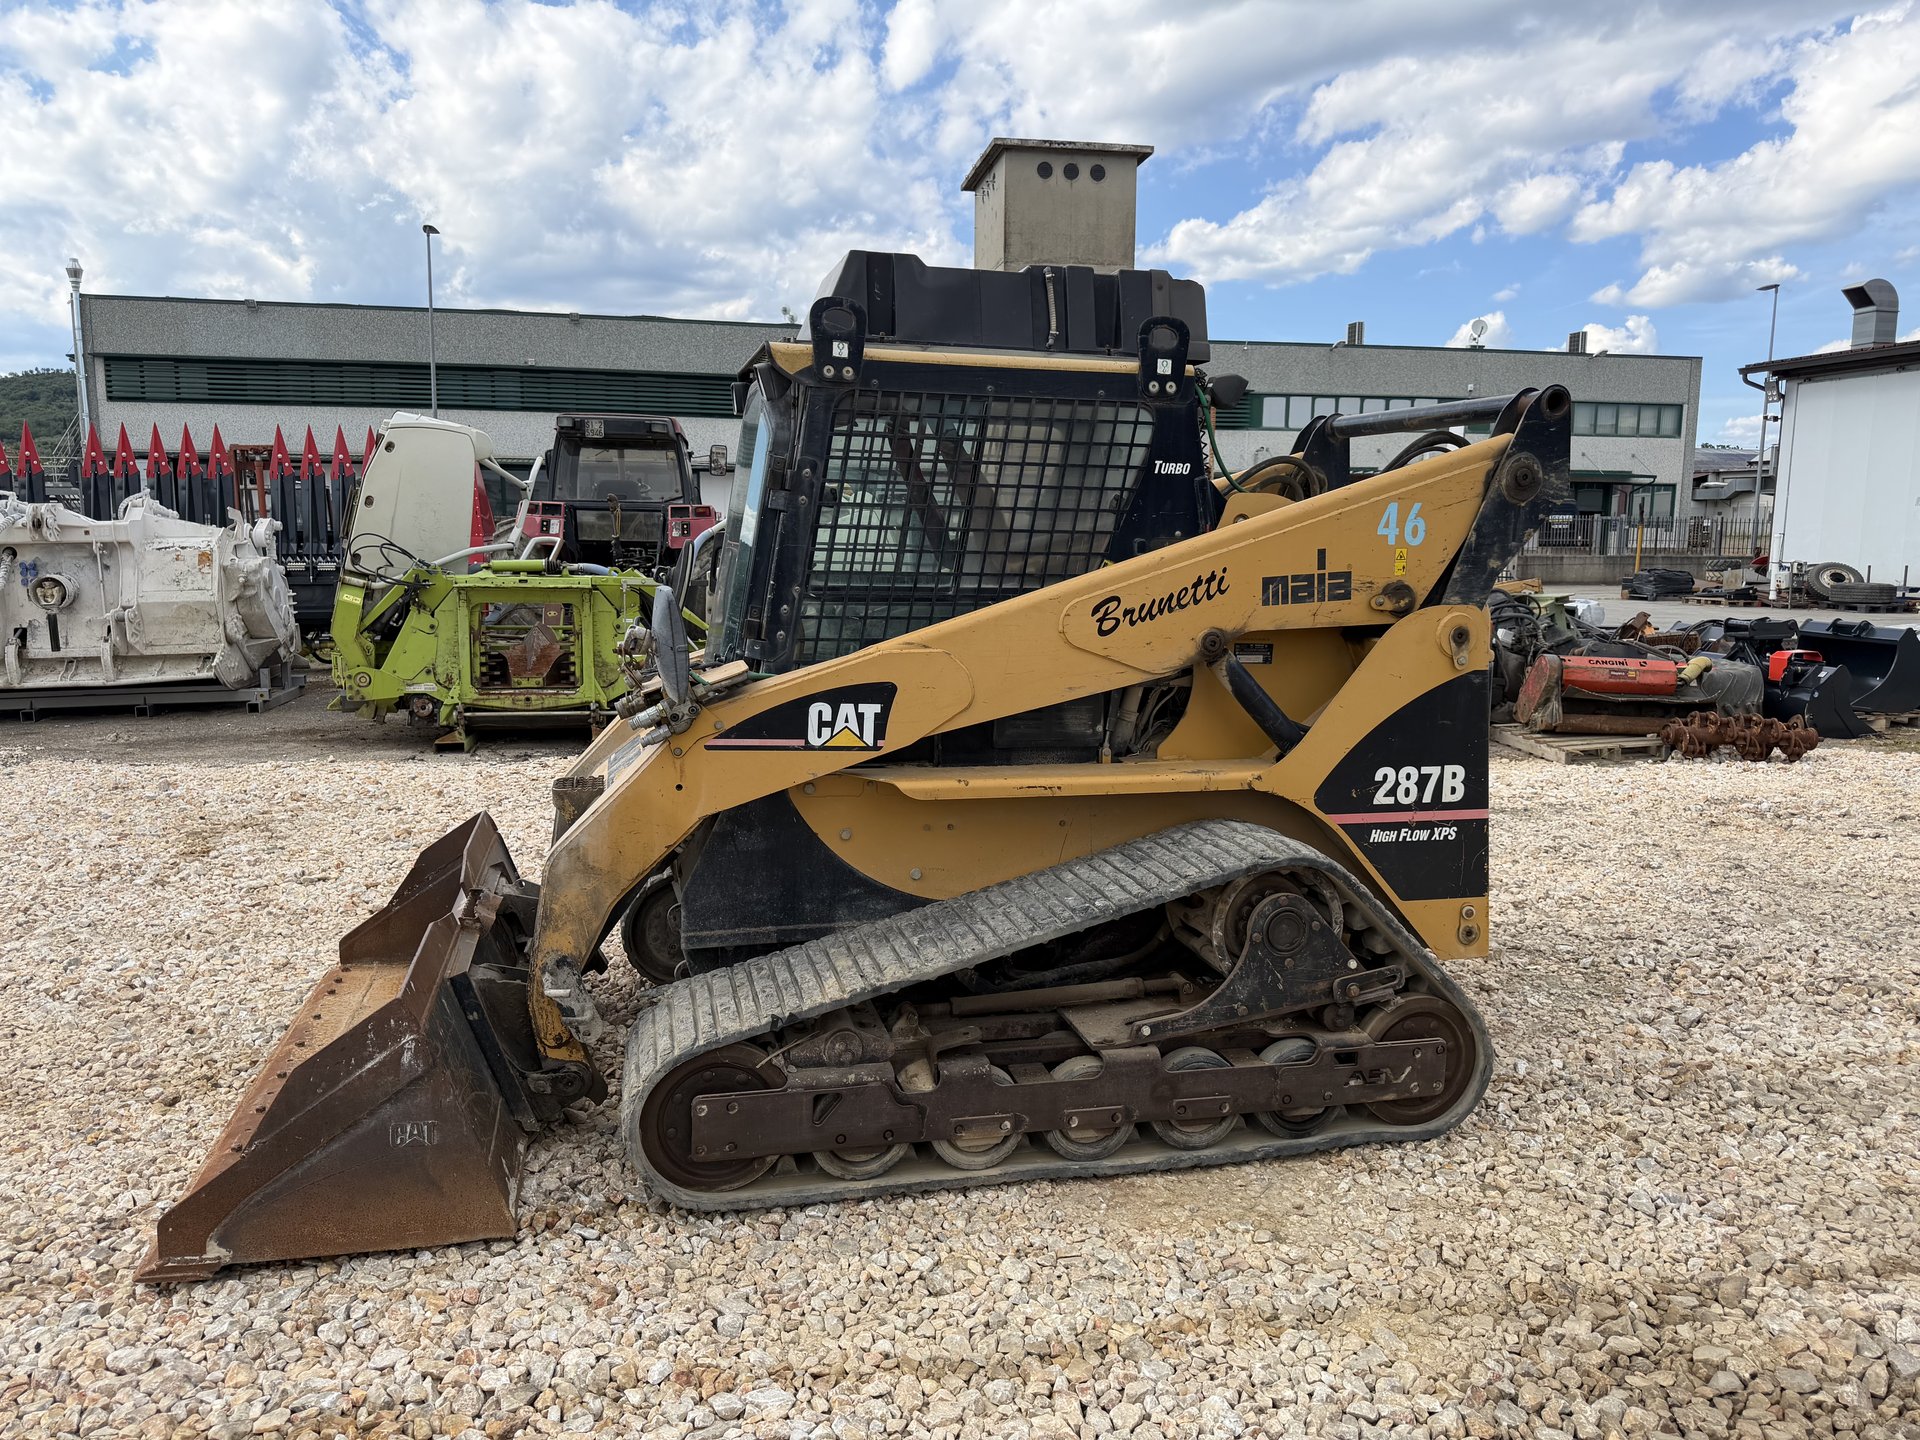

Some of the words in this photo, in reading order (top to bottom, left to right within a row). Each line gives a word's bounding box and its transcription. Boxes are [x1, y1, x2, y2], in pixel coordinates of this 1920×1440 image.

[1377, 502, 1426, 546] 46
[1091, 567, 1230, 637] Brunetti
[807, 702, 881, 746] CAT
[1372, 764, 1466, 805] 287B
[1369, 829, 1399, 843] HIGH
[1398, 828, 1431, 842] FLOW
[1431, 826, 1458, 841] XPS
[390, 1120, 438, 1148] CAT
